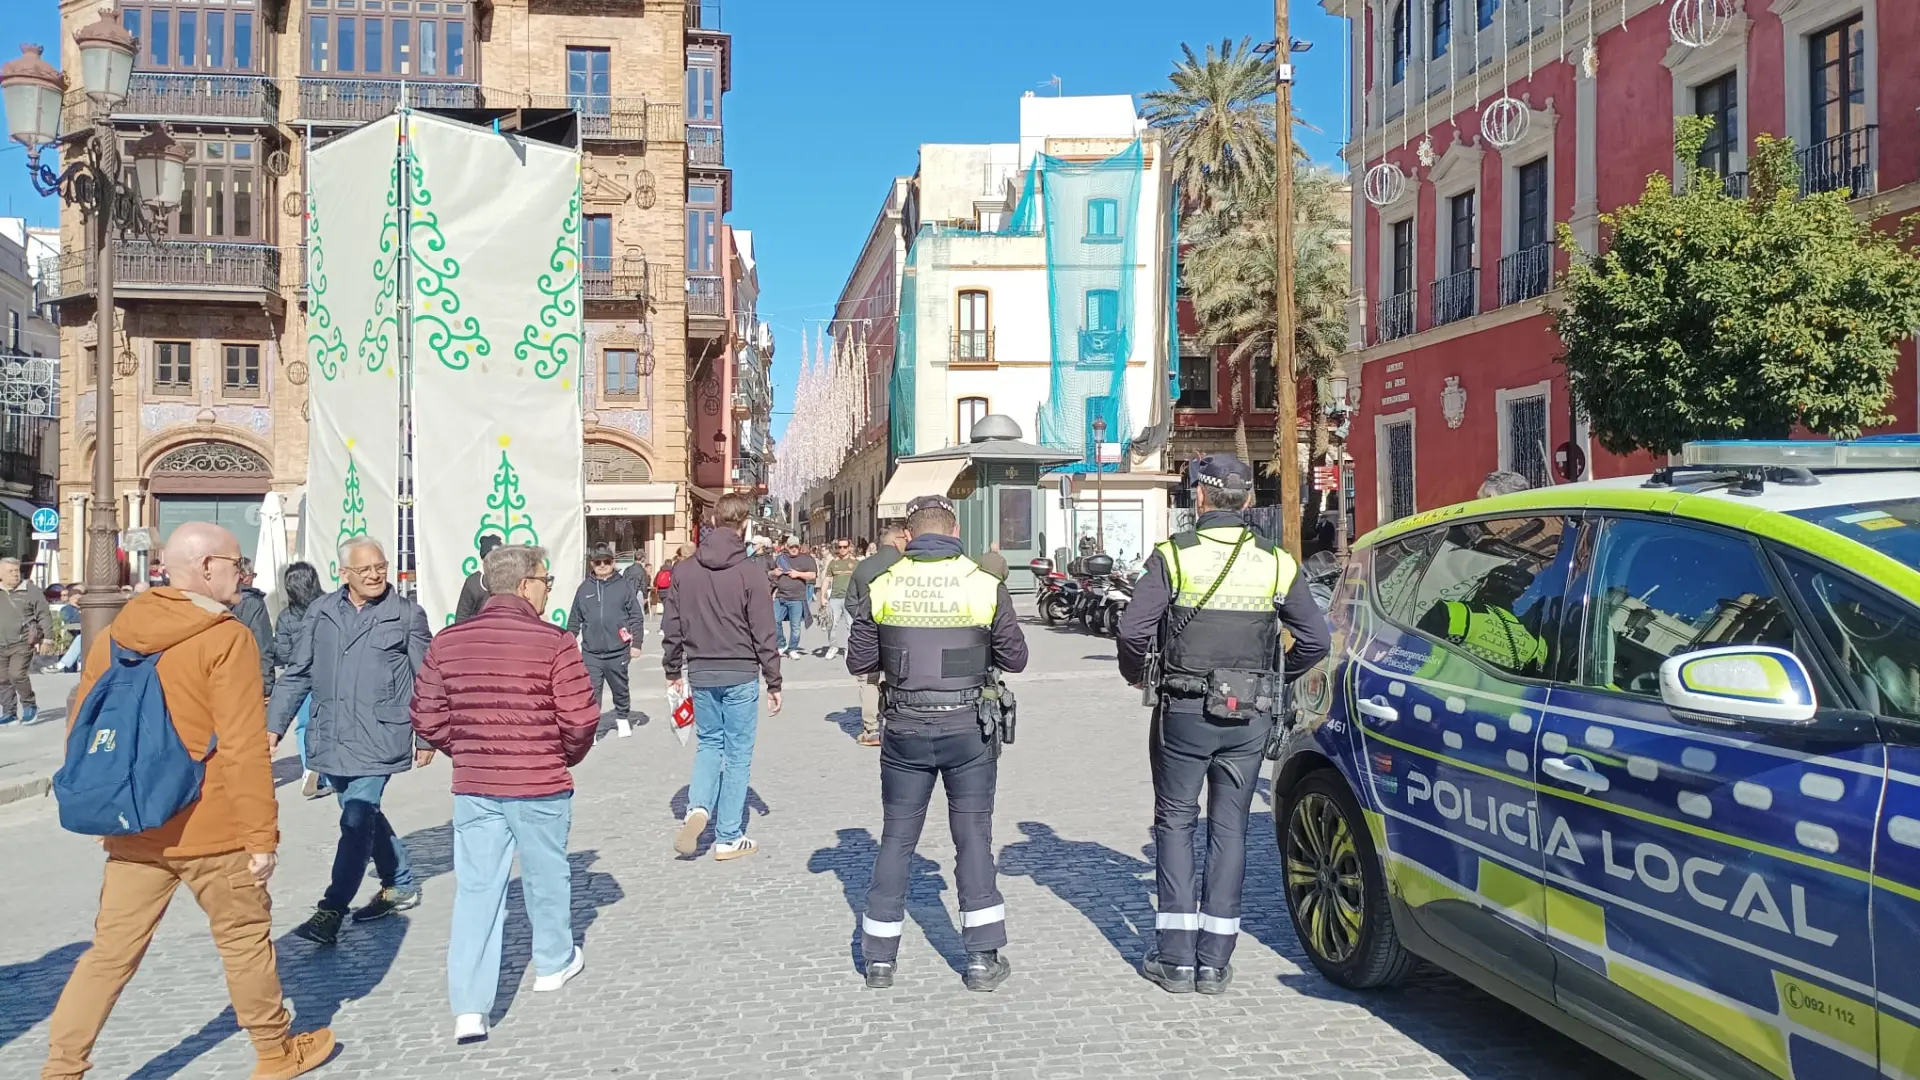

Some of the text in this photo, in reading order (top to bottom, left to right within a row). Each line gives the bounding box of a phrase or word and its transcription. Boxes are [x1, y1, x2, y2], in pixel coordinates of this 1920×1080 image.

[894, 576, 960, 588] POLICIA
[904, 589, 944, 599] LOCAL
[891, 600, 960, 614] SEVILLA
[1326, 718, 1346, 734] 461
[1407, 770, 1839, 947] POLICÍA LOCAL
[1804, 995, 1825, 1014] 092
[1834, 1007, 1856, 1026] 112
